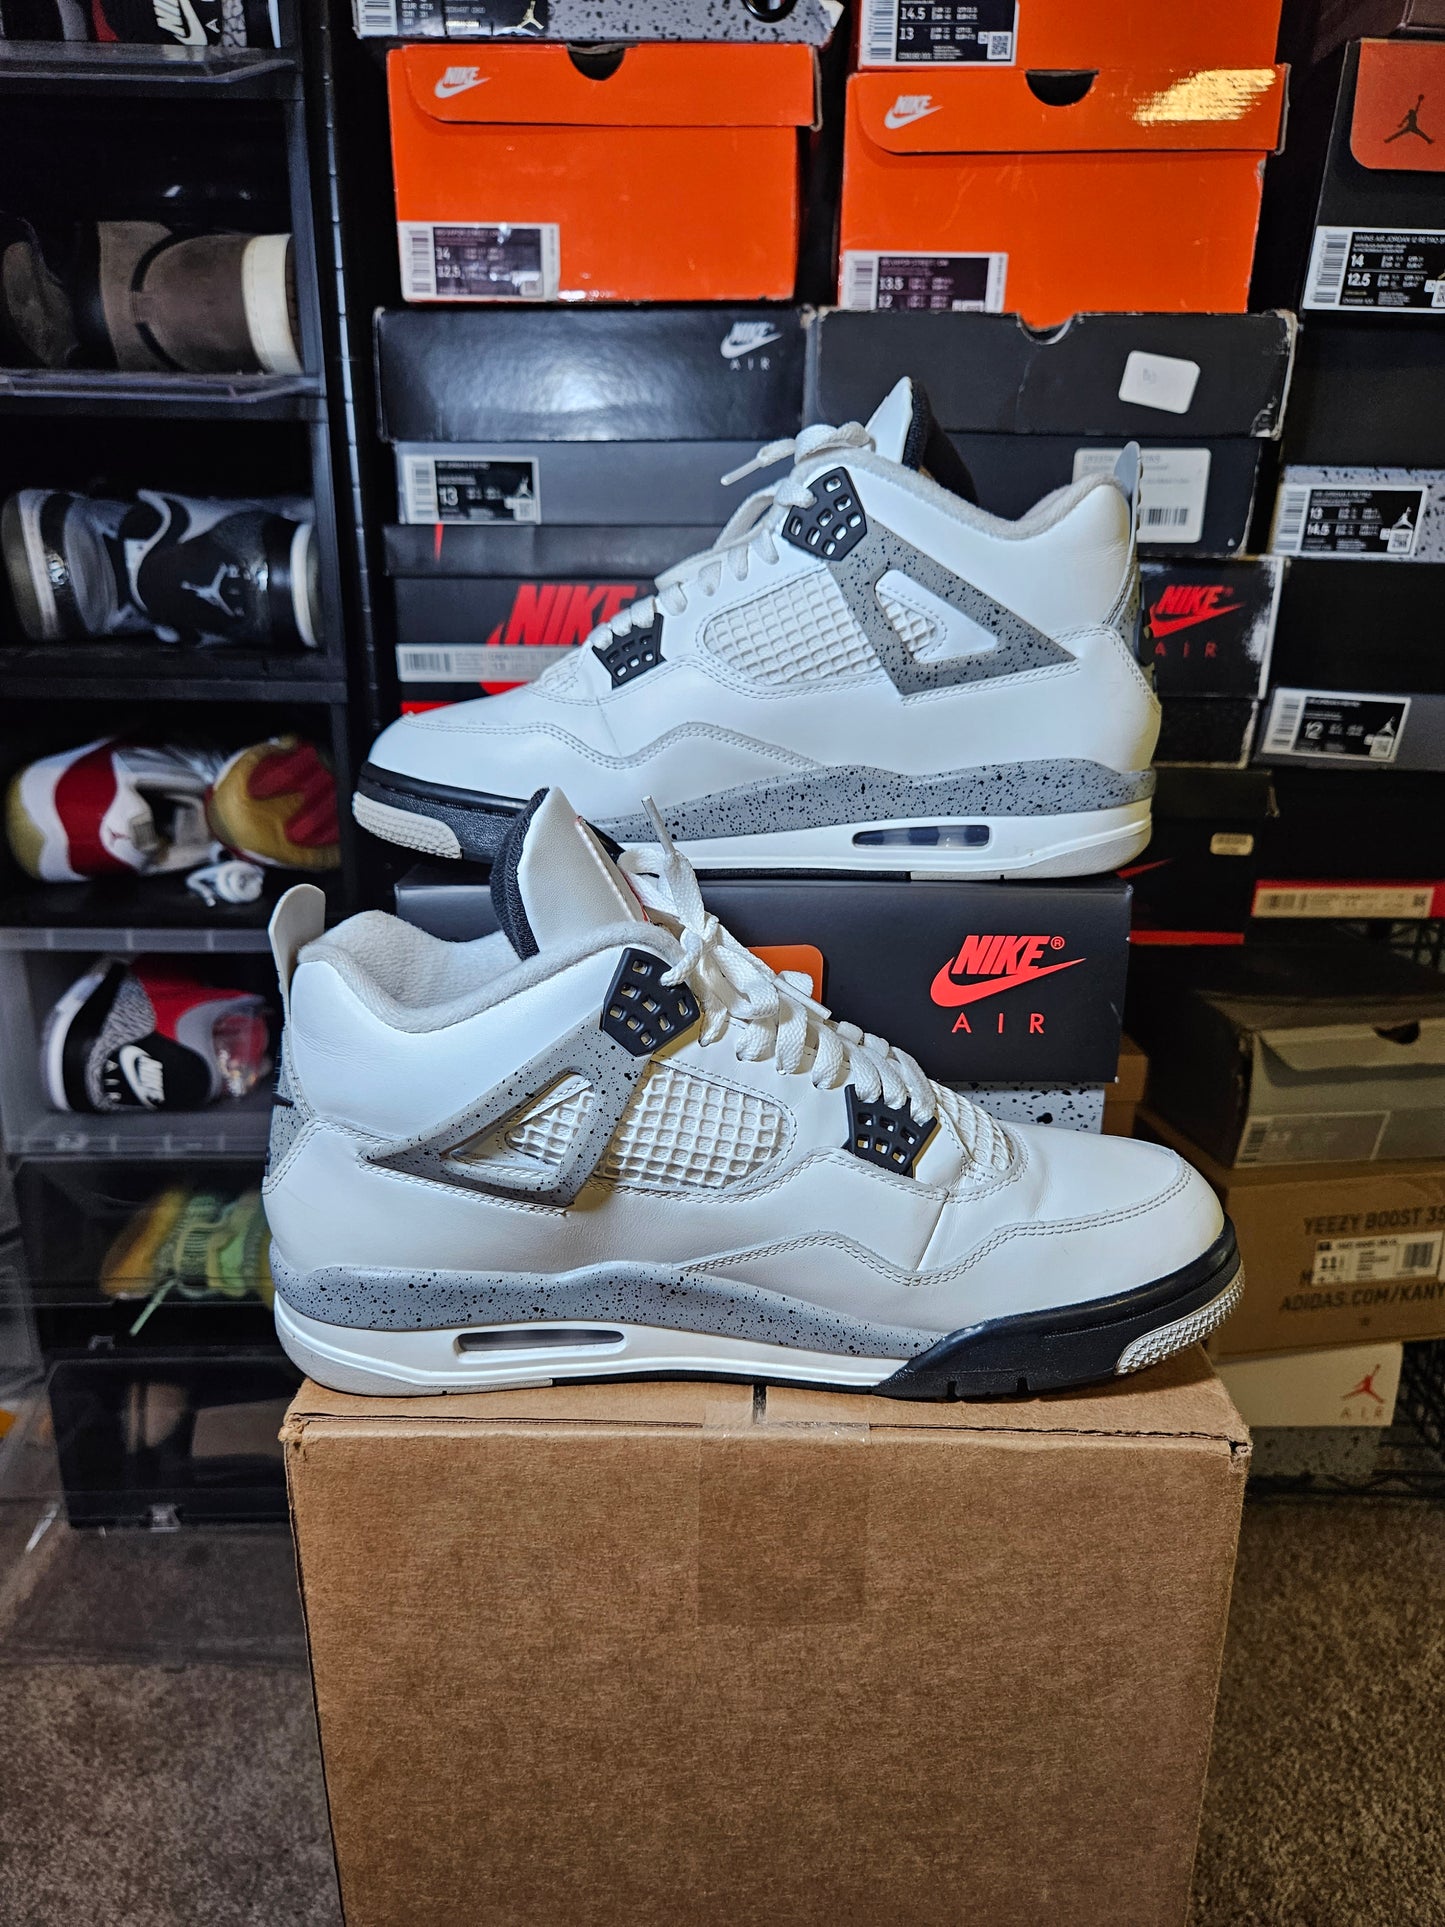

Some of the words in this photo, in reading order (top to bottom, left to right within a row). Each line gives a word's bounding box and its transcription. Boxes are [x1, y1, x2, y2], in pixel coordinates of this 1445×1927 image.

[900, 6, 926, 20] 14.5
[899, 27, 915, 40] 13
[443, 66, 480, 84] NIKE
[893, 95, 933, 114] NIKE
[1351, 254, 1365, 268] 14
[1347, 273, 1372, 287] 12.5
[729, 321, 775, 343] NIKE
[730, 356, 770, 371] AIR
[1156, 585, 1224, 615] NIKE
[1155, 641, 1218, 658] AIR
[1305, 720, 1324, 739] 12
[951, 1012, 1045, 1034] AIR
[1303, 1214, 1360, 1235] YEEZY
[1364, 1207, 1423, 1229] BOOST
[1340, 1406, 1385, 1421] AIR
